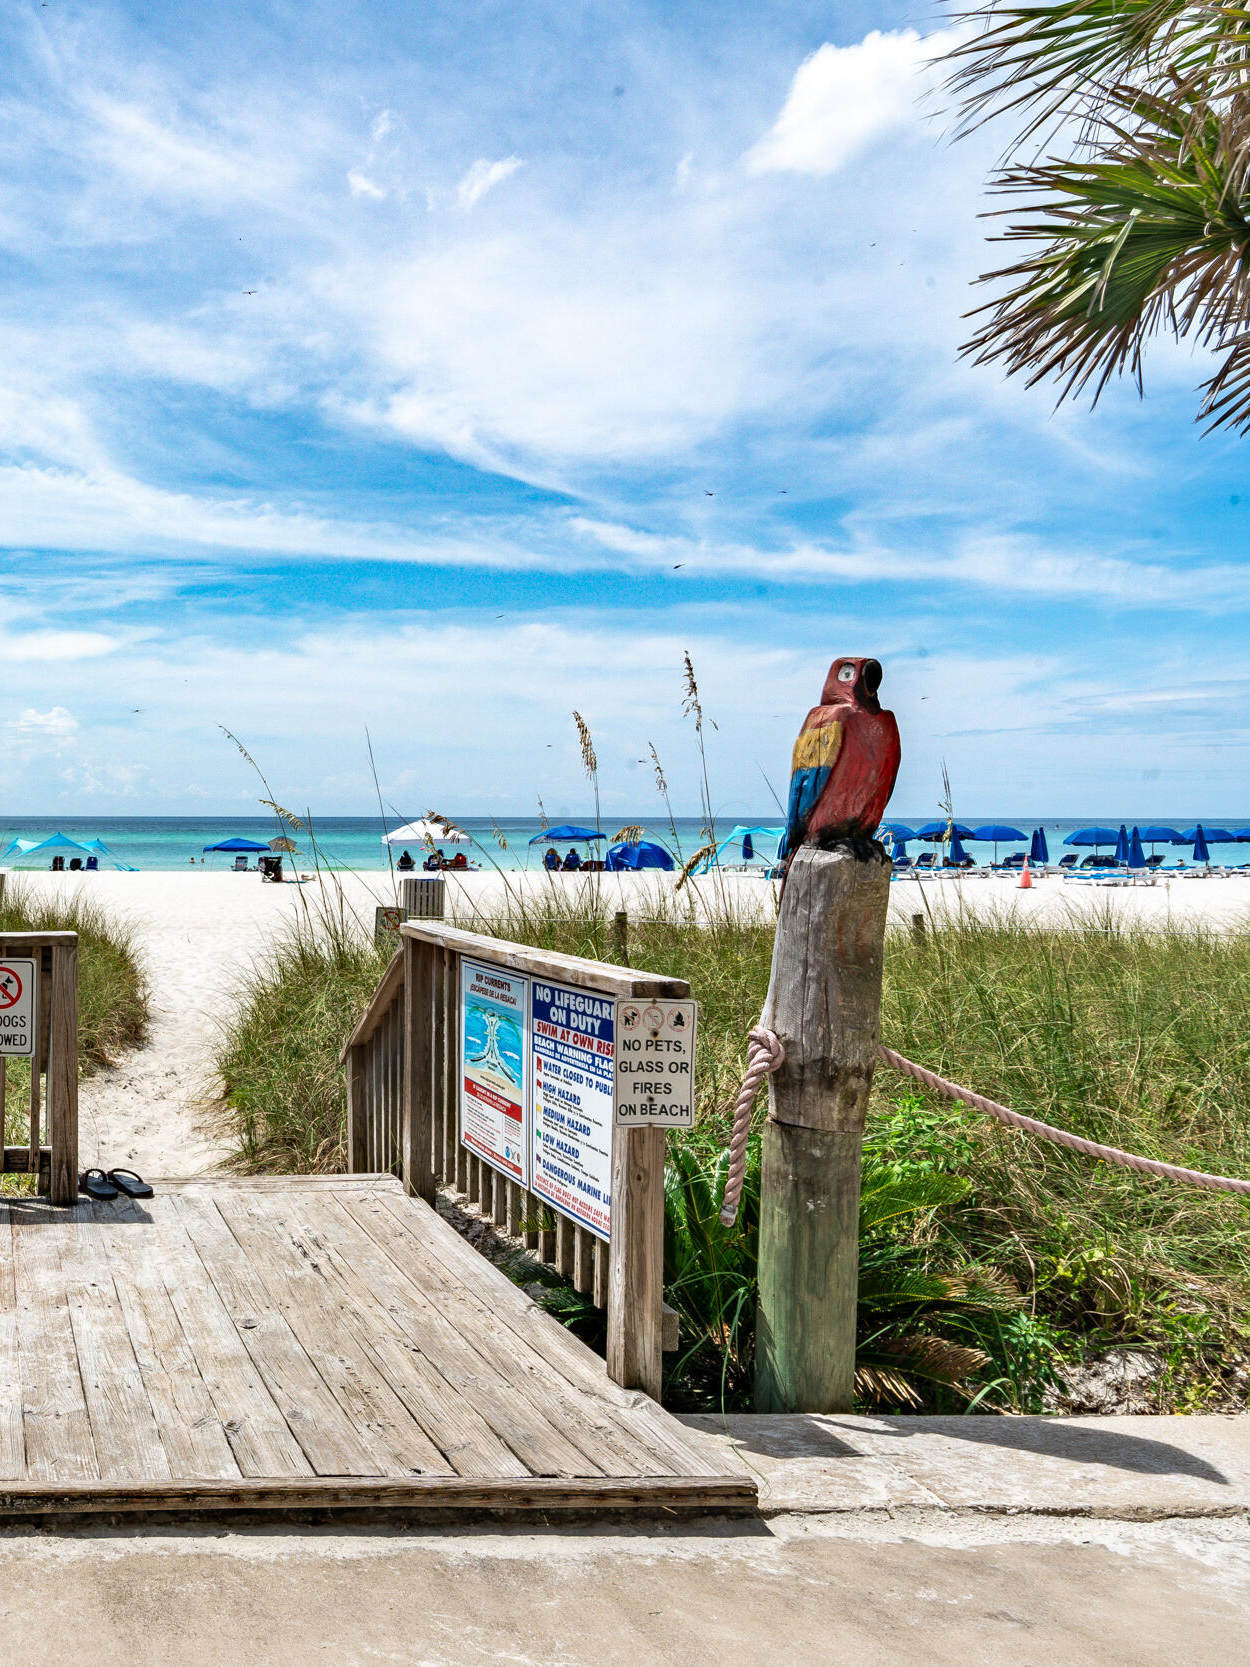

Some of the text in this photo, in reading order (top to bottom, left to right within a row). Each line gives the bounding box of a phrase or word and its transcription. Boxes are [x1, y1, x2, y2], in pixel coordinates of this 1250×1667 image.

[536, 985, 552, 1003] NO
[550, 1006, 602, 1035] ON DUTY
[534, 1035, 554, 1050] BEACH
[556, 1042, 592, 1064] WARNING
[537, 1021, 558, 1038] SWIM
[560, 1028, 570, 1042] AT
[572, 1032, 594, 1051] OWN
[622, 1040, 686, 1054] NO PETS,
[543, 1060, 562, 1075] WATER
[563, 1068, 584, 1084] CLOSED
[586, 1076, 593, 1088] TO
[619, 1061, 689, 1074] GLASS OR
[543, 1081, 556, 1095] HIGH
[558, 1088, 580, 1106] HAZARD
[633, 1082, 672, 1094] FIRES
[543, 1106, 566, 1124] MEDIUM
[566, 1117, 590, 1136] HAZARD
[619, 1104, 689, 1116] ON BEACH
[543, 1132, 556, 1146] LOW
[556, 1139, 580, 1159] HAZARD
[542, 1159, 576, 1186] DANGEROUS
[577, 1179, 602, 1200] MARINE
